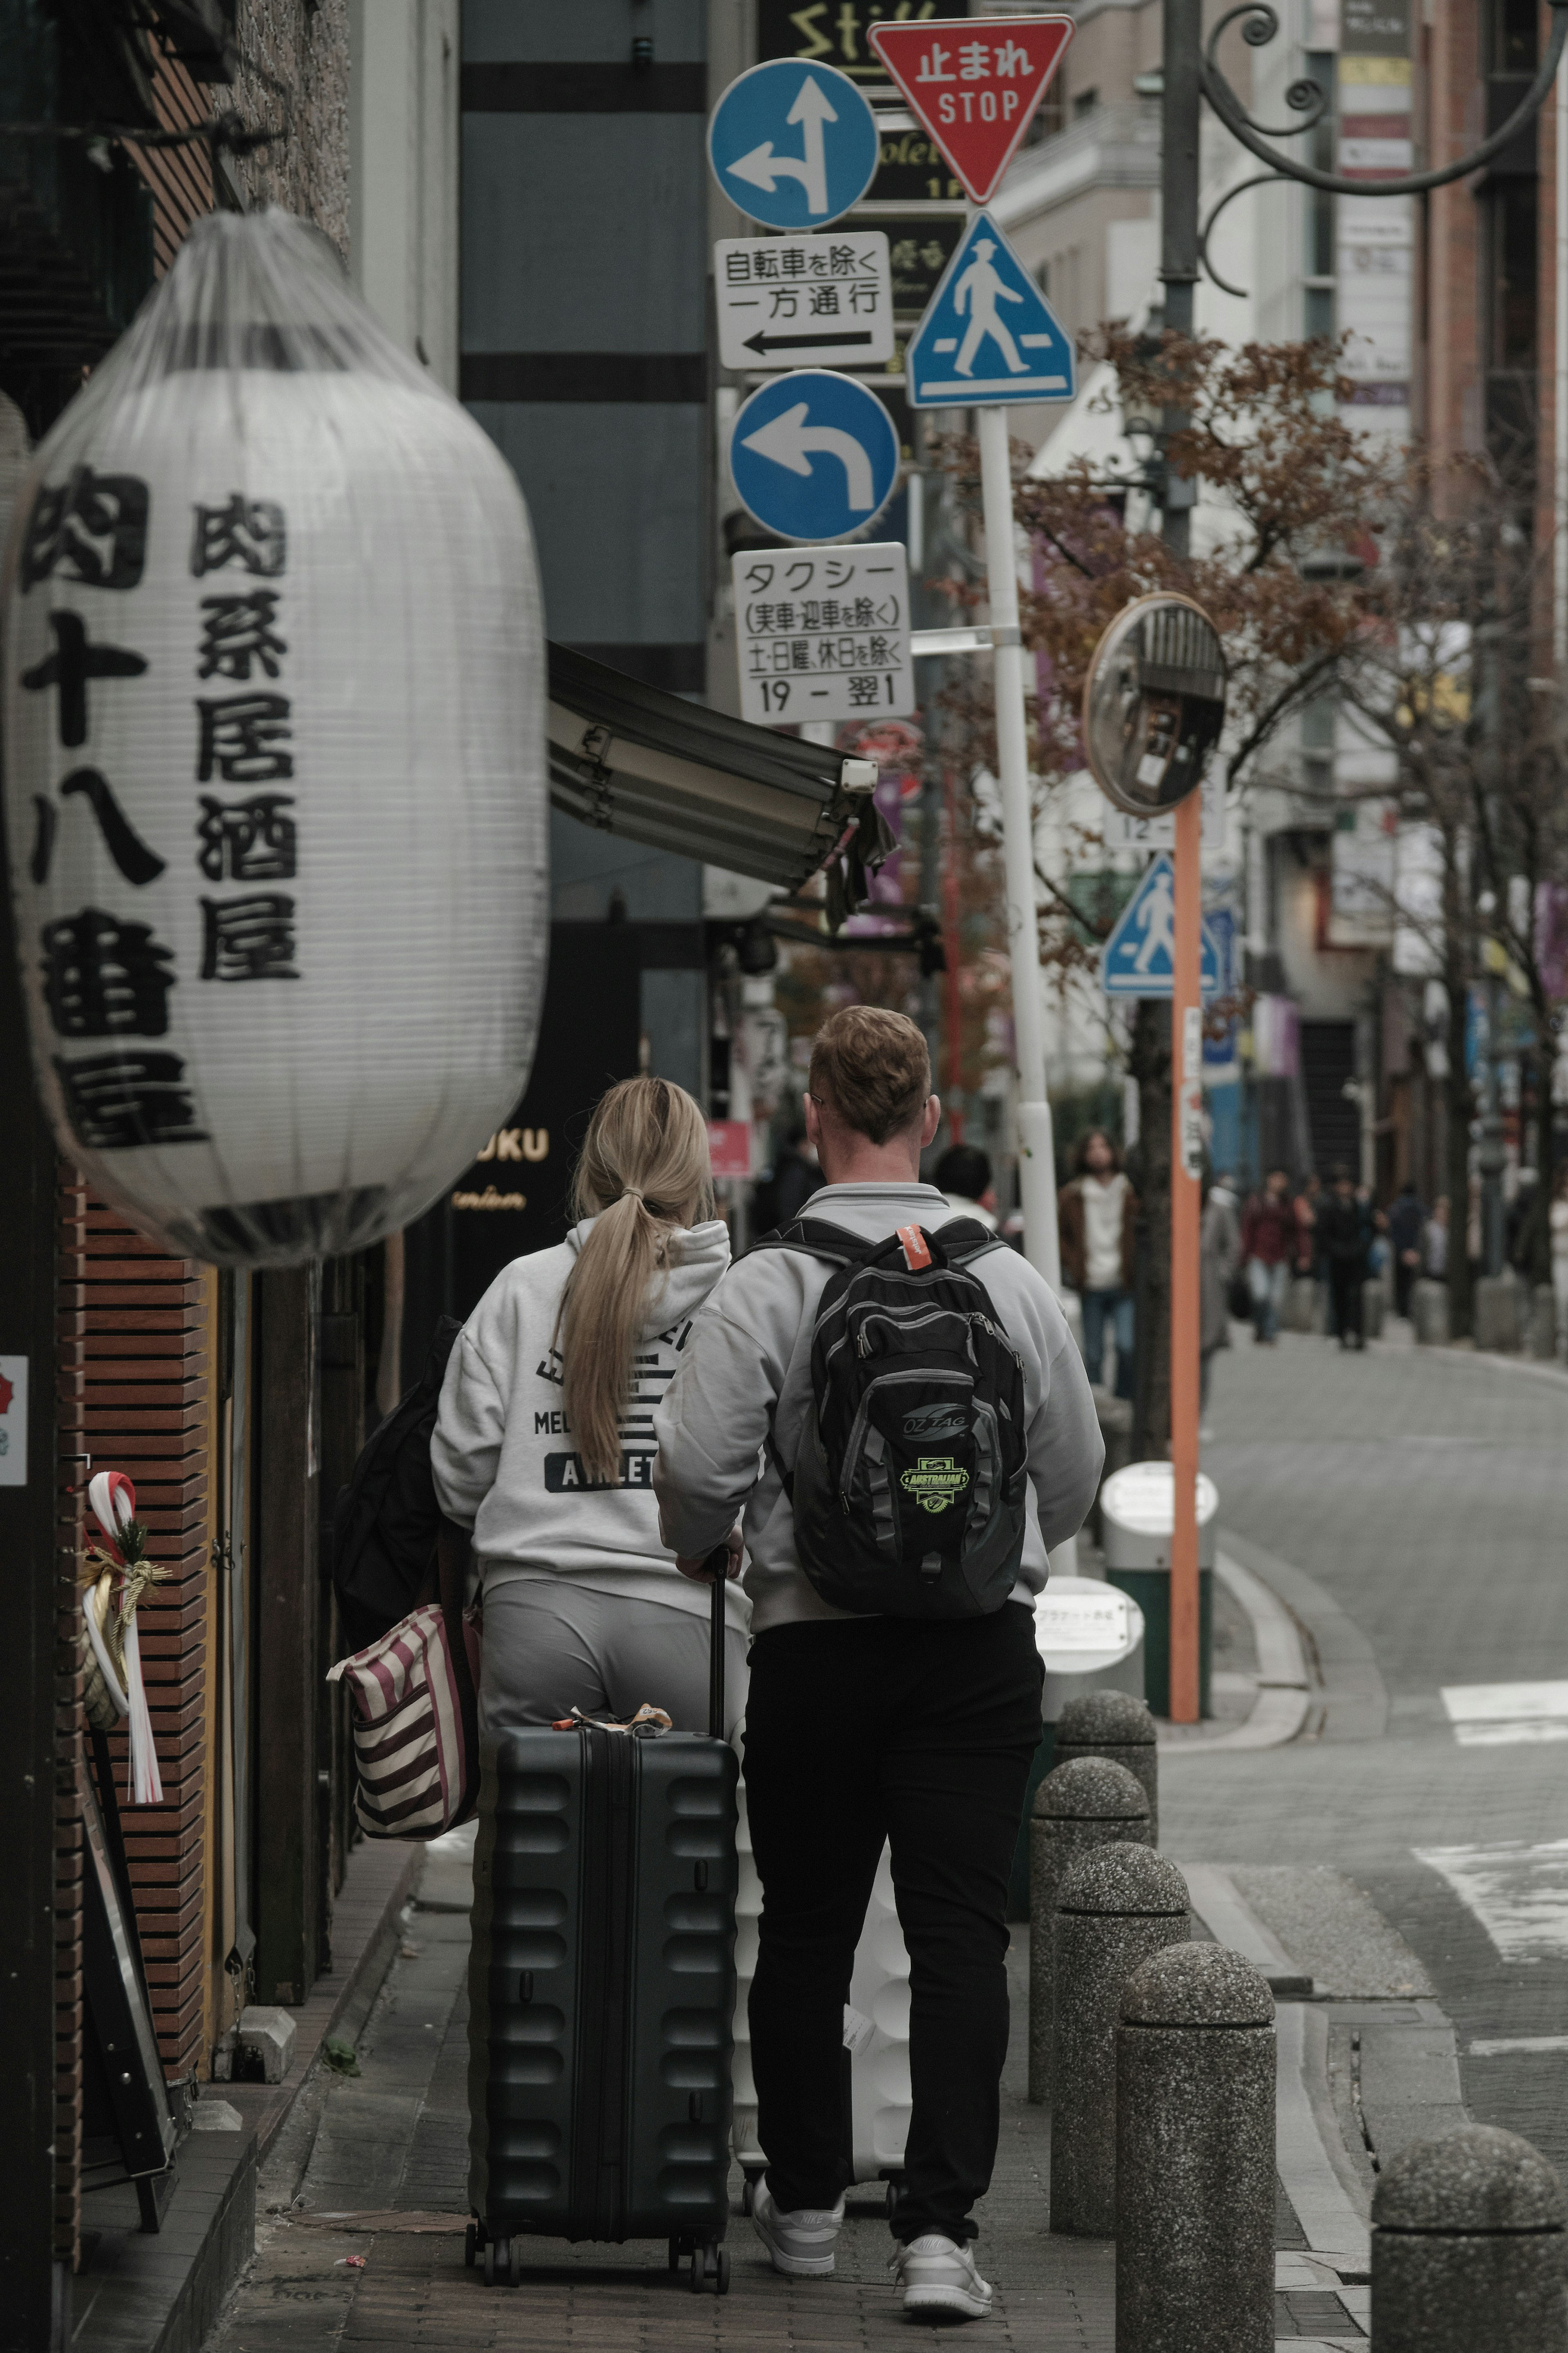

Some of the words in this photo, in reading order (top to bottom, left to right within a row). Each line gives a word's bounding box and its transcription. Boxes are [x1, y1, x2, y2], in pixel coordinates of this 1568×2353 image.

[915, 40, 1034, 82] 止まれ
[939, 90, 1018, 123] STOP
[726, 245, 878, 281] 自転車を除く
[728, 283, 880, 319] 一方通行
[745, 560, 894, 594] タクシー
[190, 493, 301, 981] 肉系居酒屋
[908, 1228, 922, 1254] Jetstar
[909, 1474, 962, 1485] AUSTRALIAN
[799, 2214, 824, 2224] NIKE
[918, 2238, 943, 2251] NIKE
